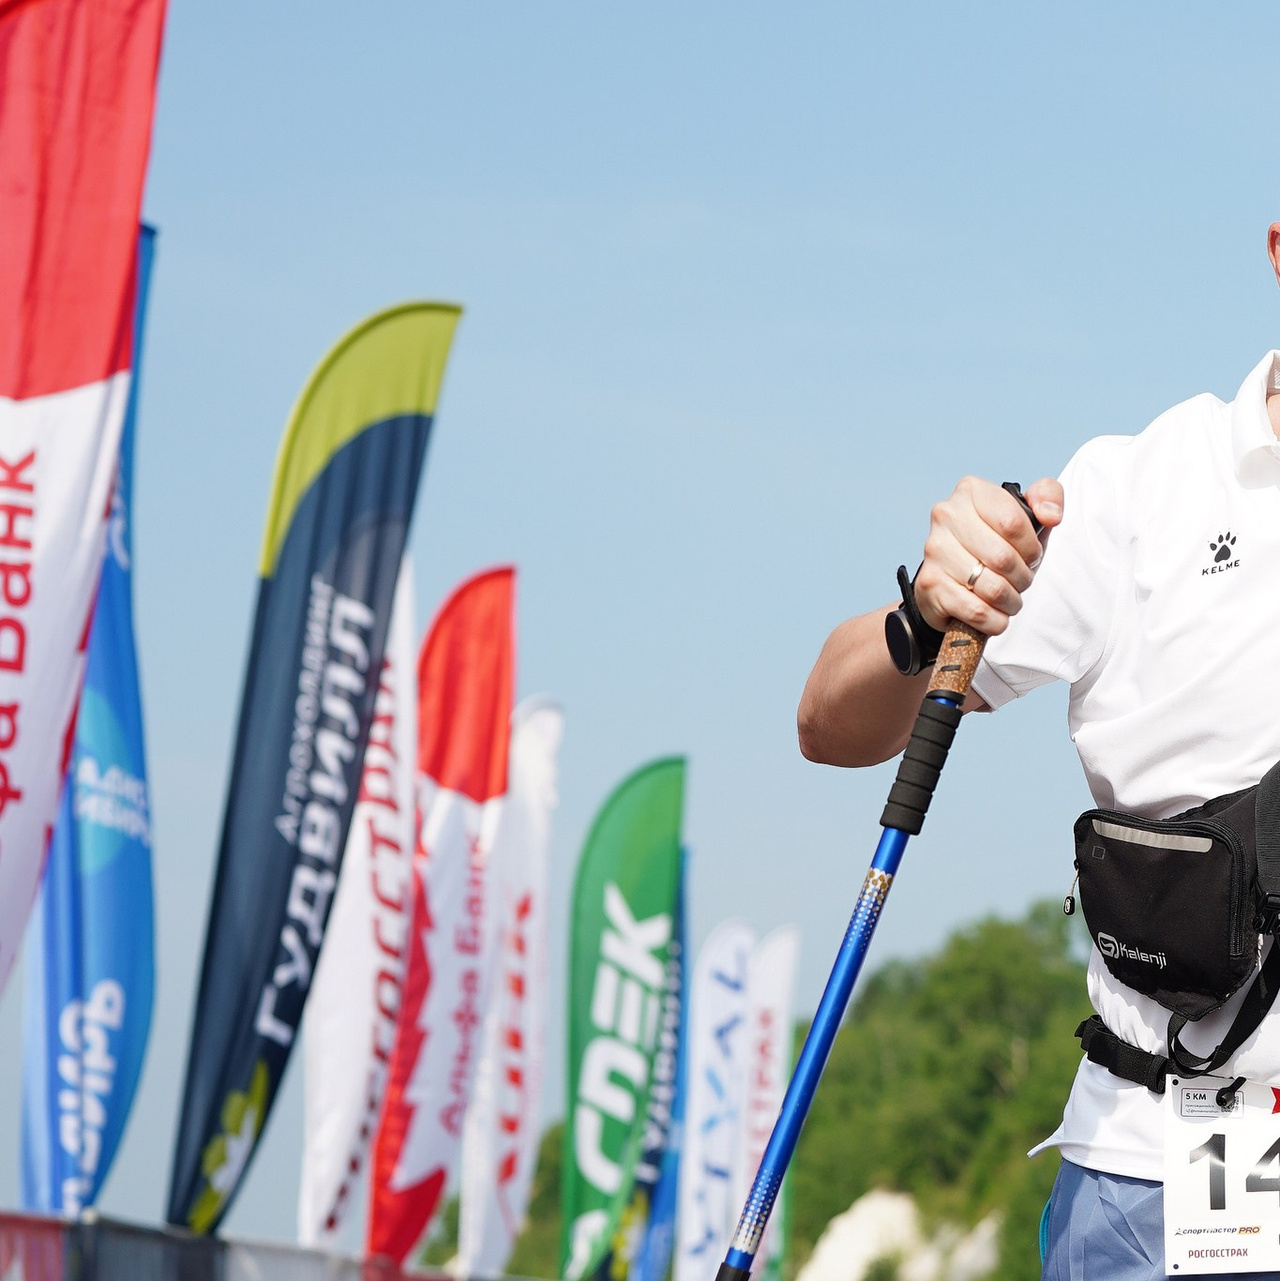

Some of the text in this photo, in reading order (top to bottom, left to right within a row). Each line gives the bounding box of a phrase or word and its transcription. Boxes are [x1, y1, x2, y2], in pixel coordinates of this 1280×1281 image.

[1202, 559, 1240, 576] KELME
[1119, 942, 1167, 969] Kalenji
[573, 883, 671, 1196] CDEK
[1185, 1092, 1191, 1100] 5
[1238, 1226, 1260, 1234] PRO
[1188, 1248, 1248, 1259] РОСГОССТРАХ
